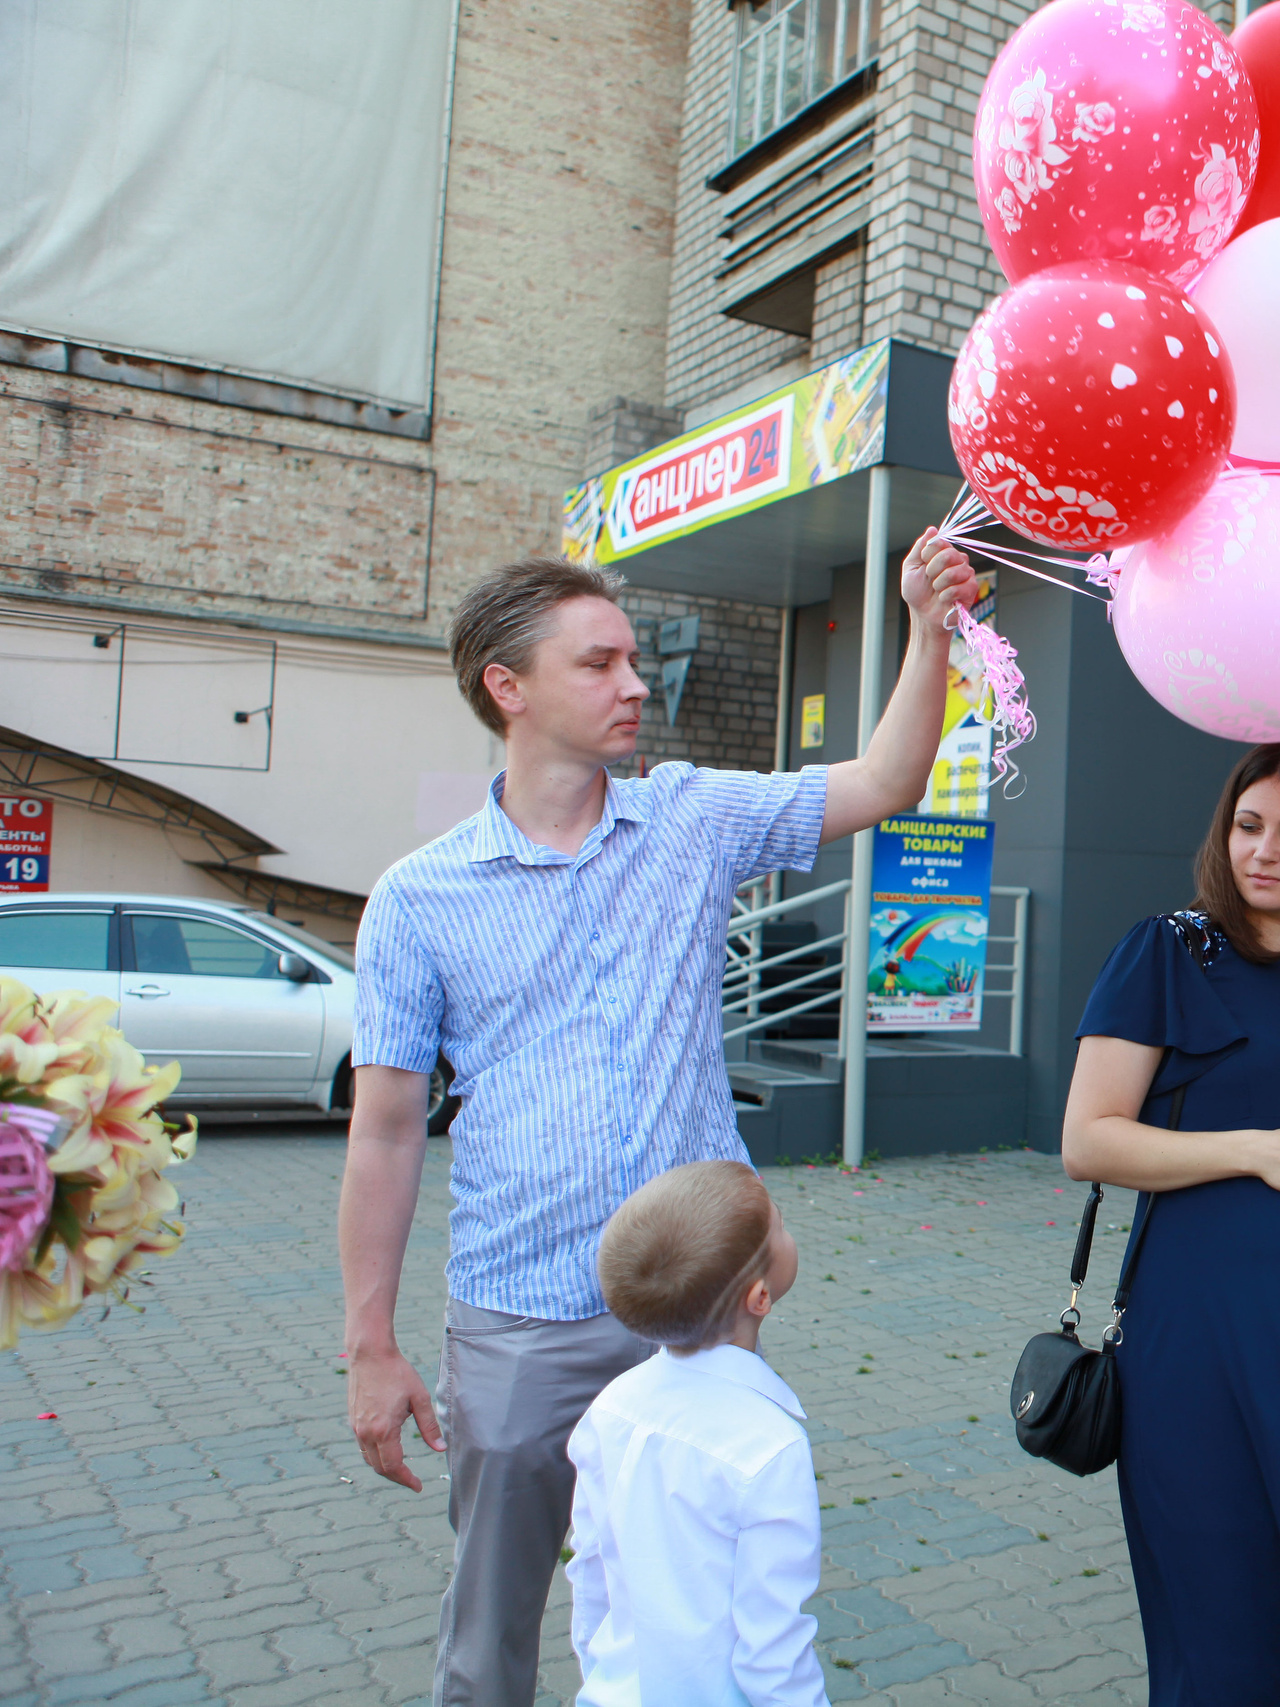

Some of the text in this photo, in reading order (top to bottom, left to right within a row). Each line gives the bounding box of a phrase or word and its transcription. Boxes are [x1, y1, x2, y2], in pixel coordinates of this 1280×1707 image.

[613, 420, 778, 541] Канцлер 24
[972, 466, 1129, 538] Люблю
[0, 798, 43, 818] ТО
[0, 830, 46, 842] ЕНТЫ
[880, 820, 987, 838] КАНЦЕЛЯРСКИЕ
[902, 837, 964, 853] ТОВАРЫ
[5, 857, 40, 881] 19
